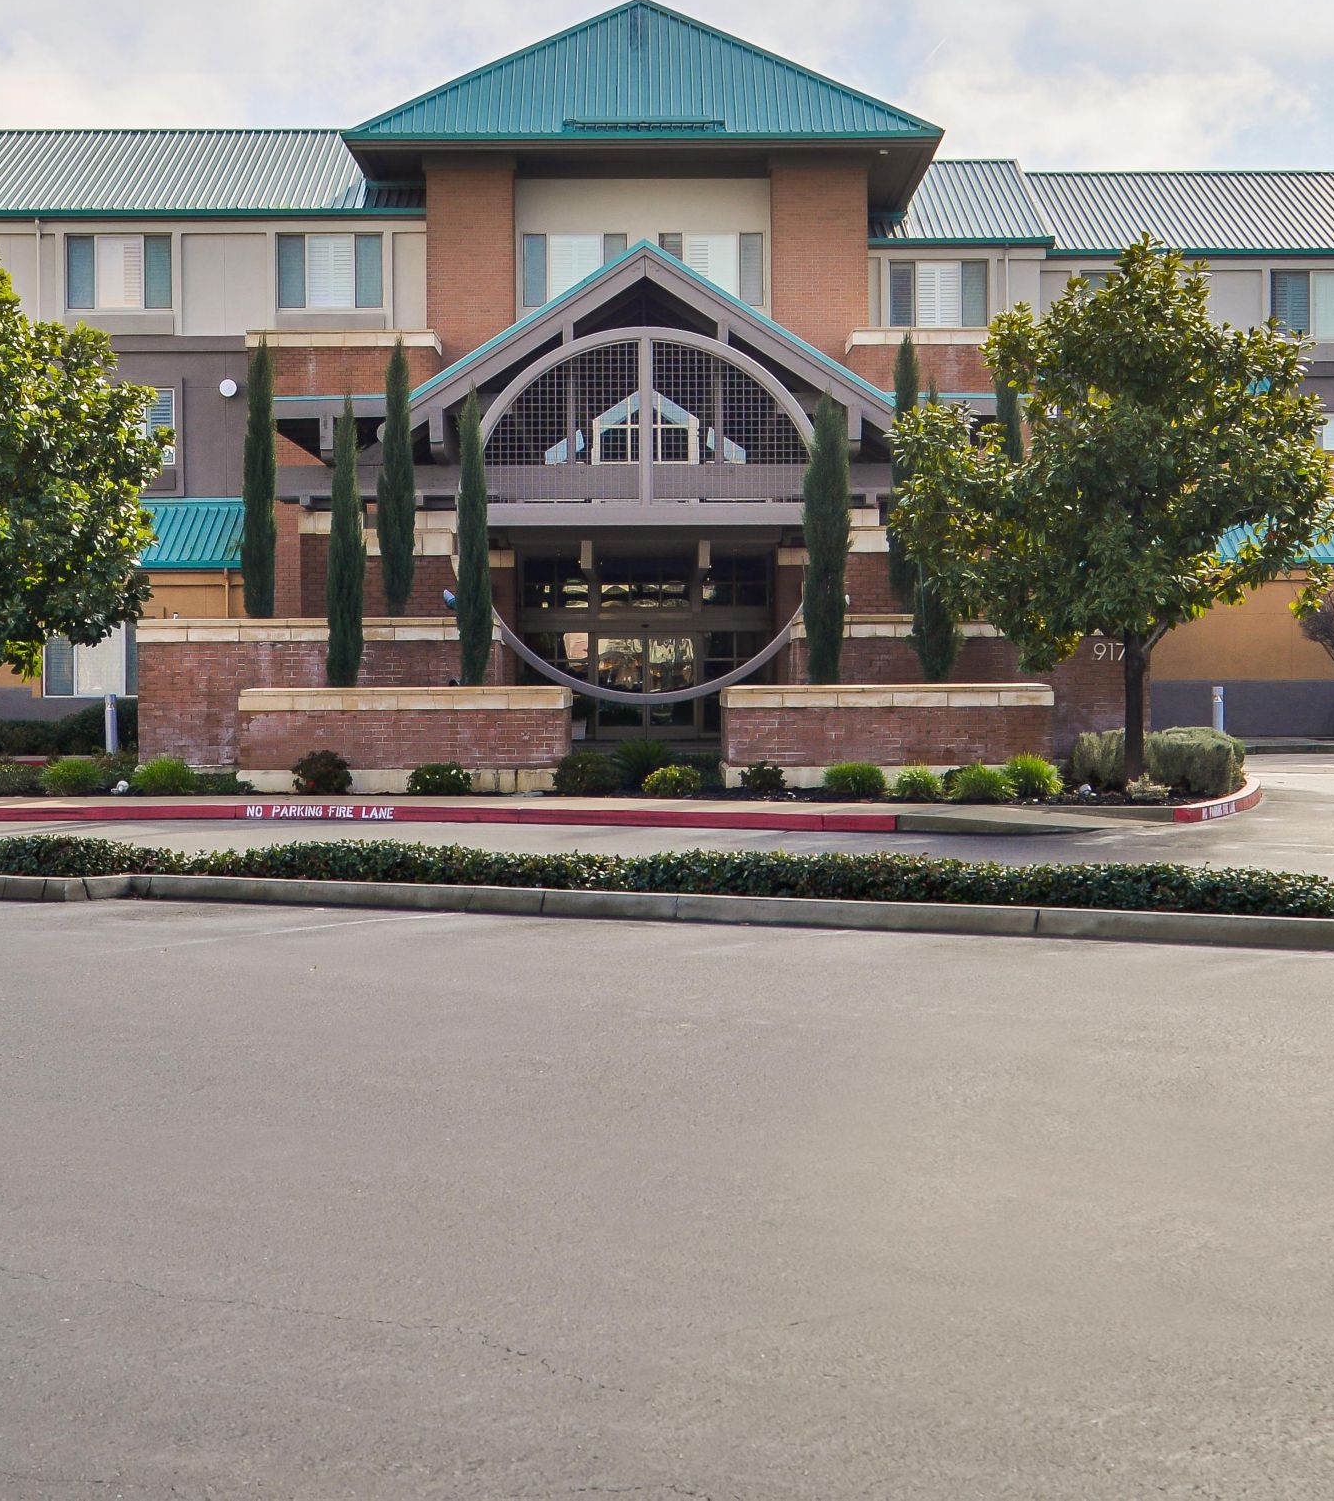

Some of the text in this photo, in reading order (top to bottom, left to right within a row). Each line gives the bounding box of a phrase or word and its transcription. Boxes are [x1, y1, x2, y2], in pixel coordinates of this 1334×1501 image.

[1093, 643, 1125, 660] 917
[246, 806, 394, 819] NO PARKING FIRE LANE
